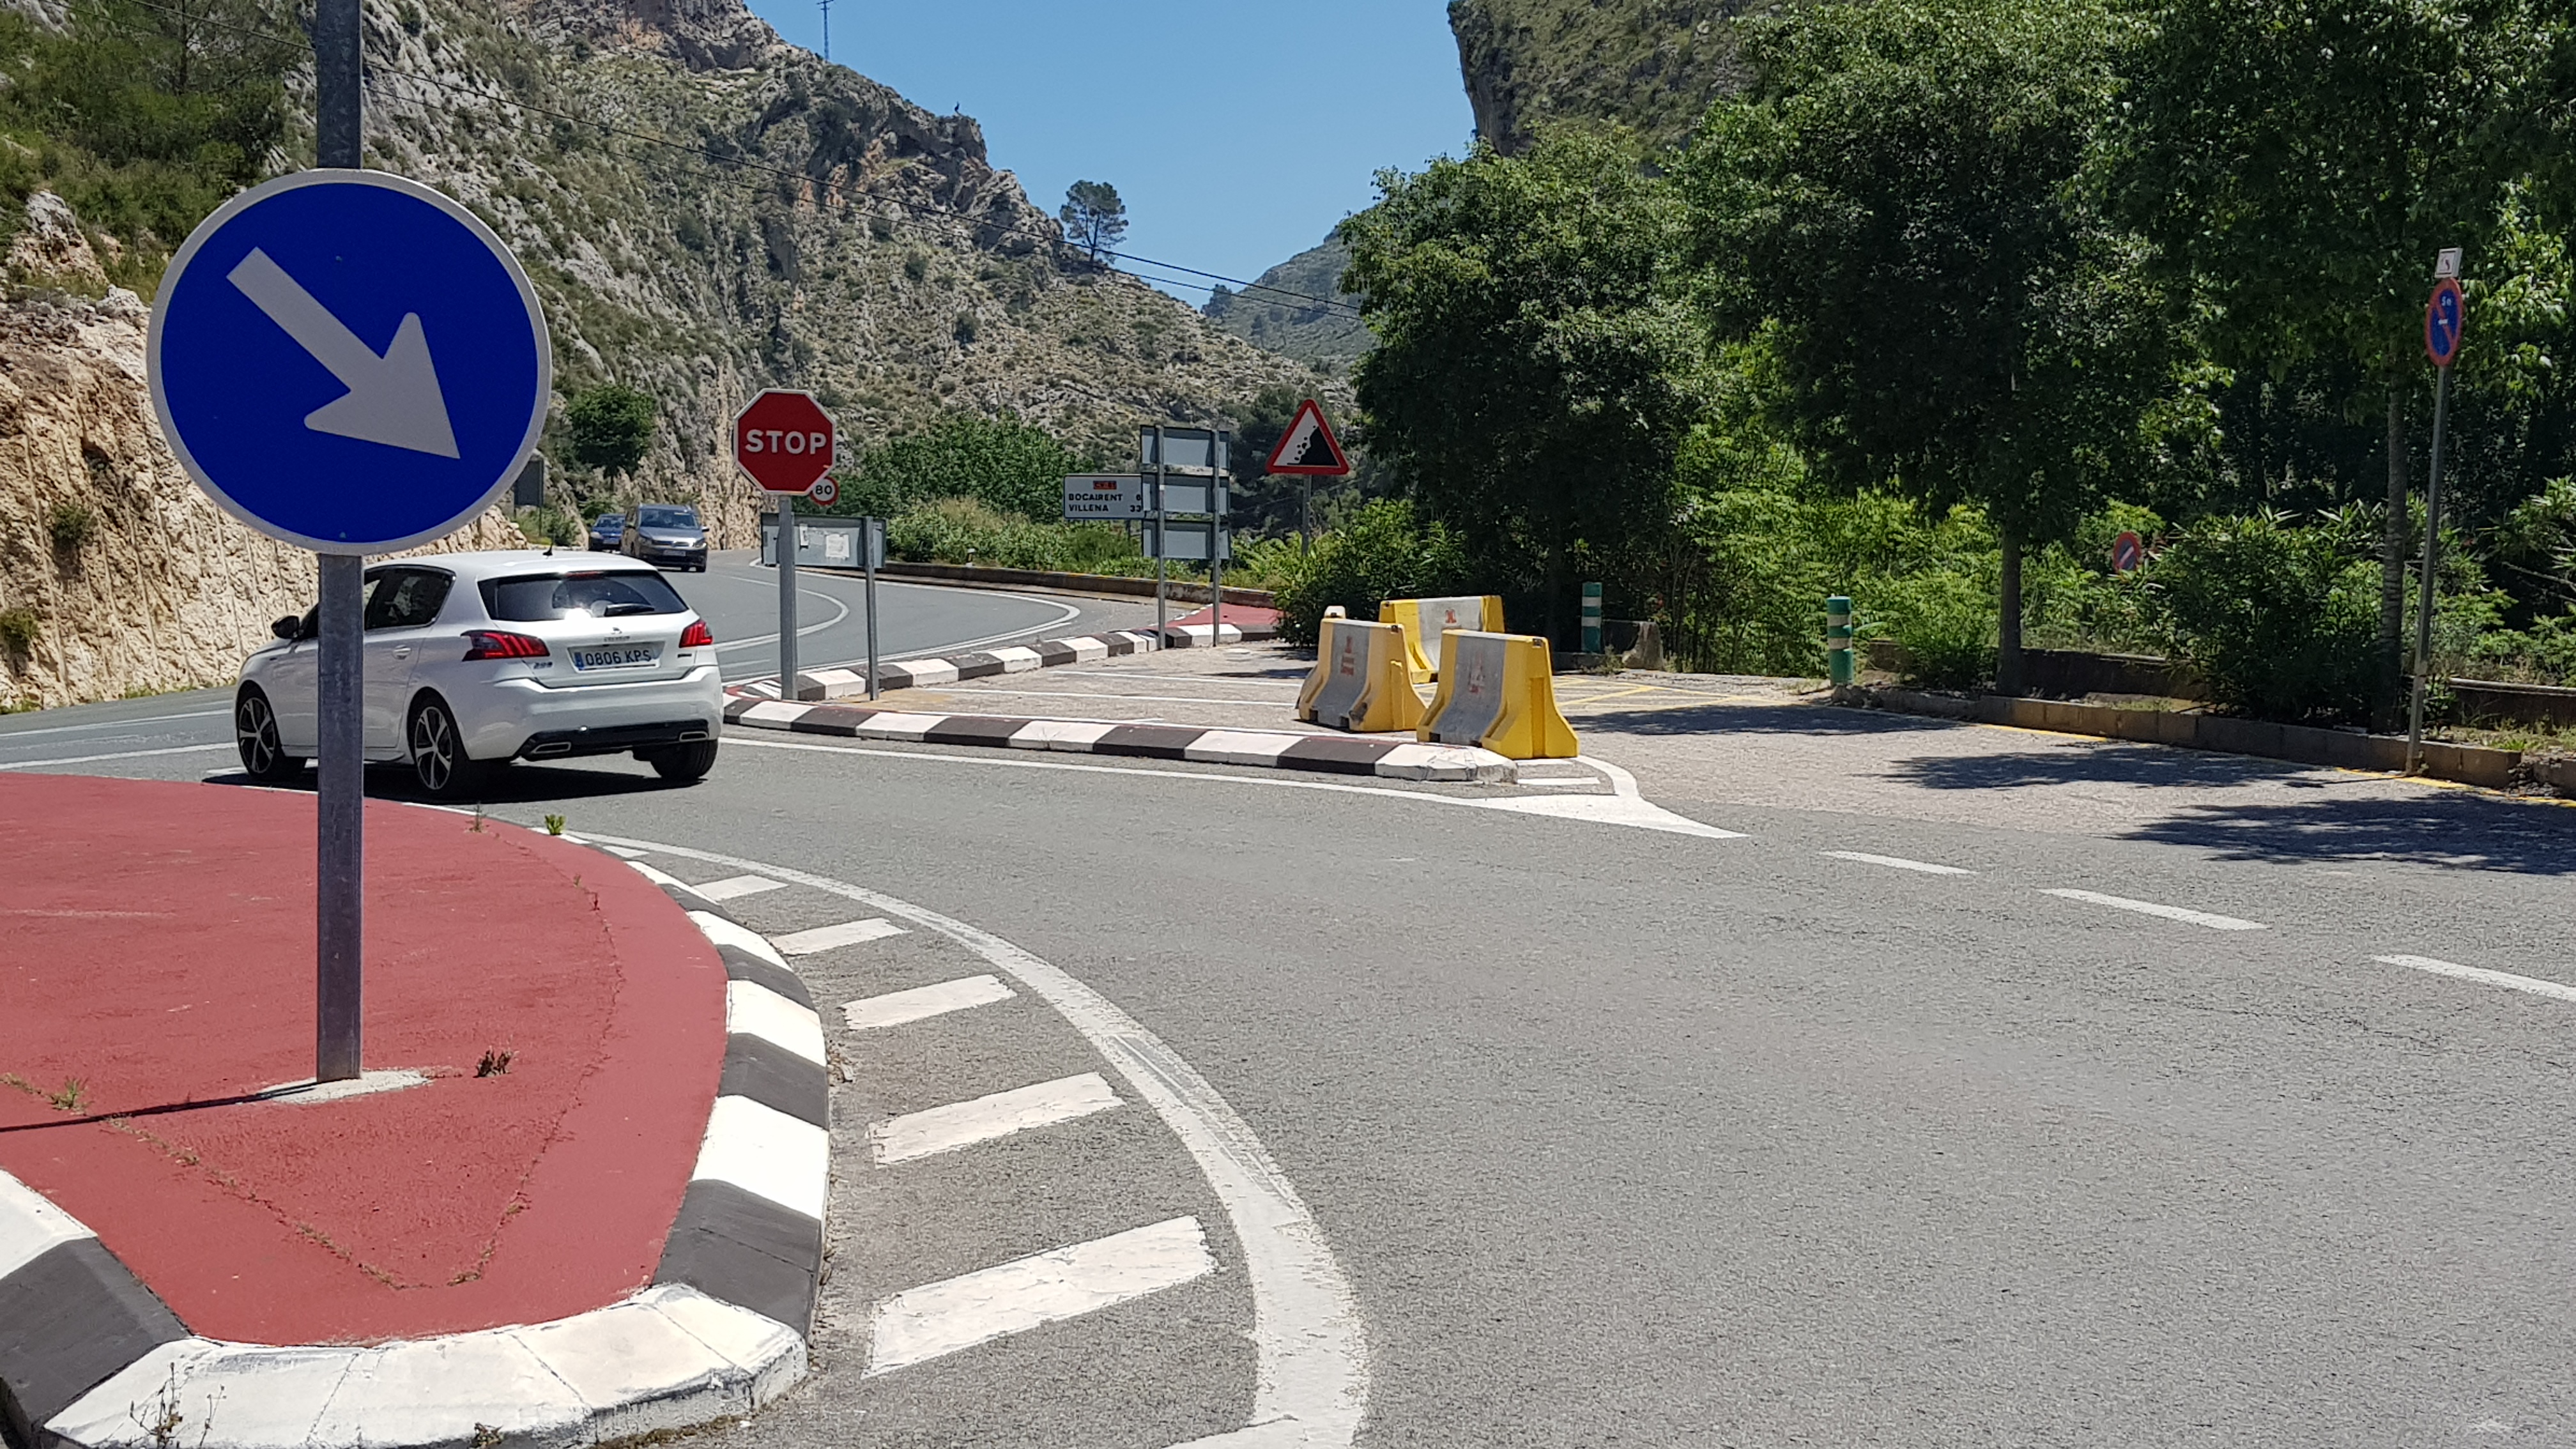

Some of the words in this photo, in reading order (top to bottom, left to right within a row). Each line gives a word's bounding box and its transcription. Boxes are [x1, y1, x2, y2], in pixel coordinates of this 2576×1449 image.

[745, 429, 827, 454] STOP
[815, 484, 832, 494] 80
[585, 652, 621, 666] 0806
[625, 650, 651, 663] KPS
